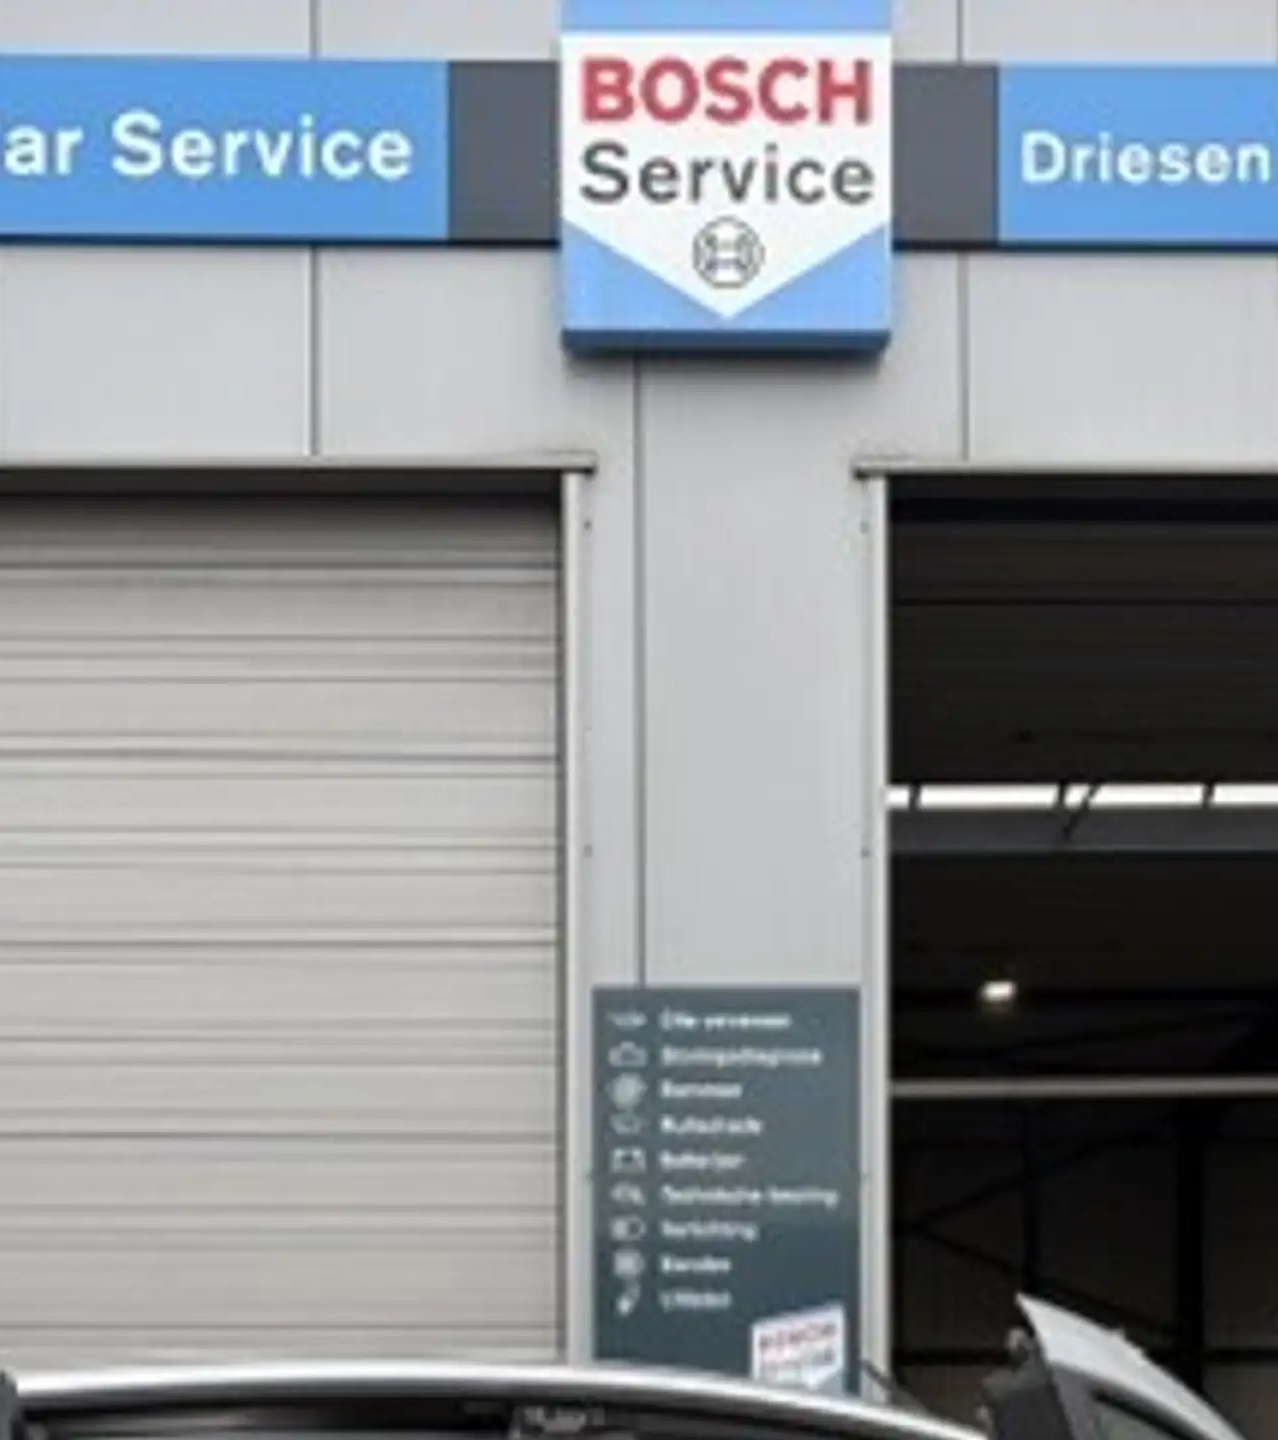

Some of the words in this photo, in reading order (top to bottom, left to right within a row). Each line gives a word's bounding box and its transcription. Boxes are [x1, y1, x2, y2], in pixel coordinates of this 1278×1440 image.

[581, 57, 872, 125] BOSCH
[112, 109, 413, 180] Service
[580, 140, 875, 205] Service
[1021, 129, 1272, 184] Driesen
